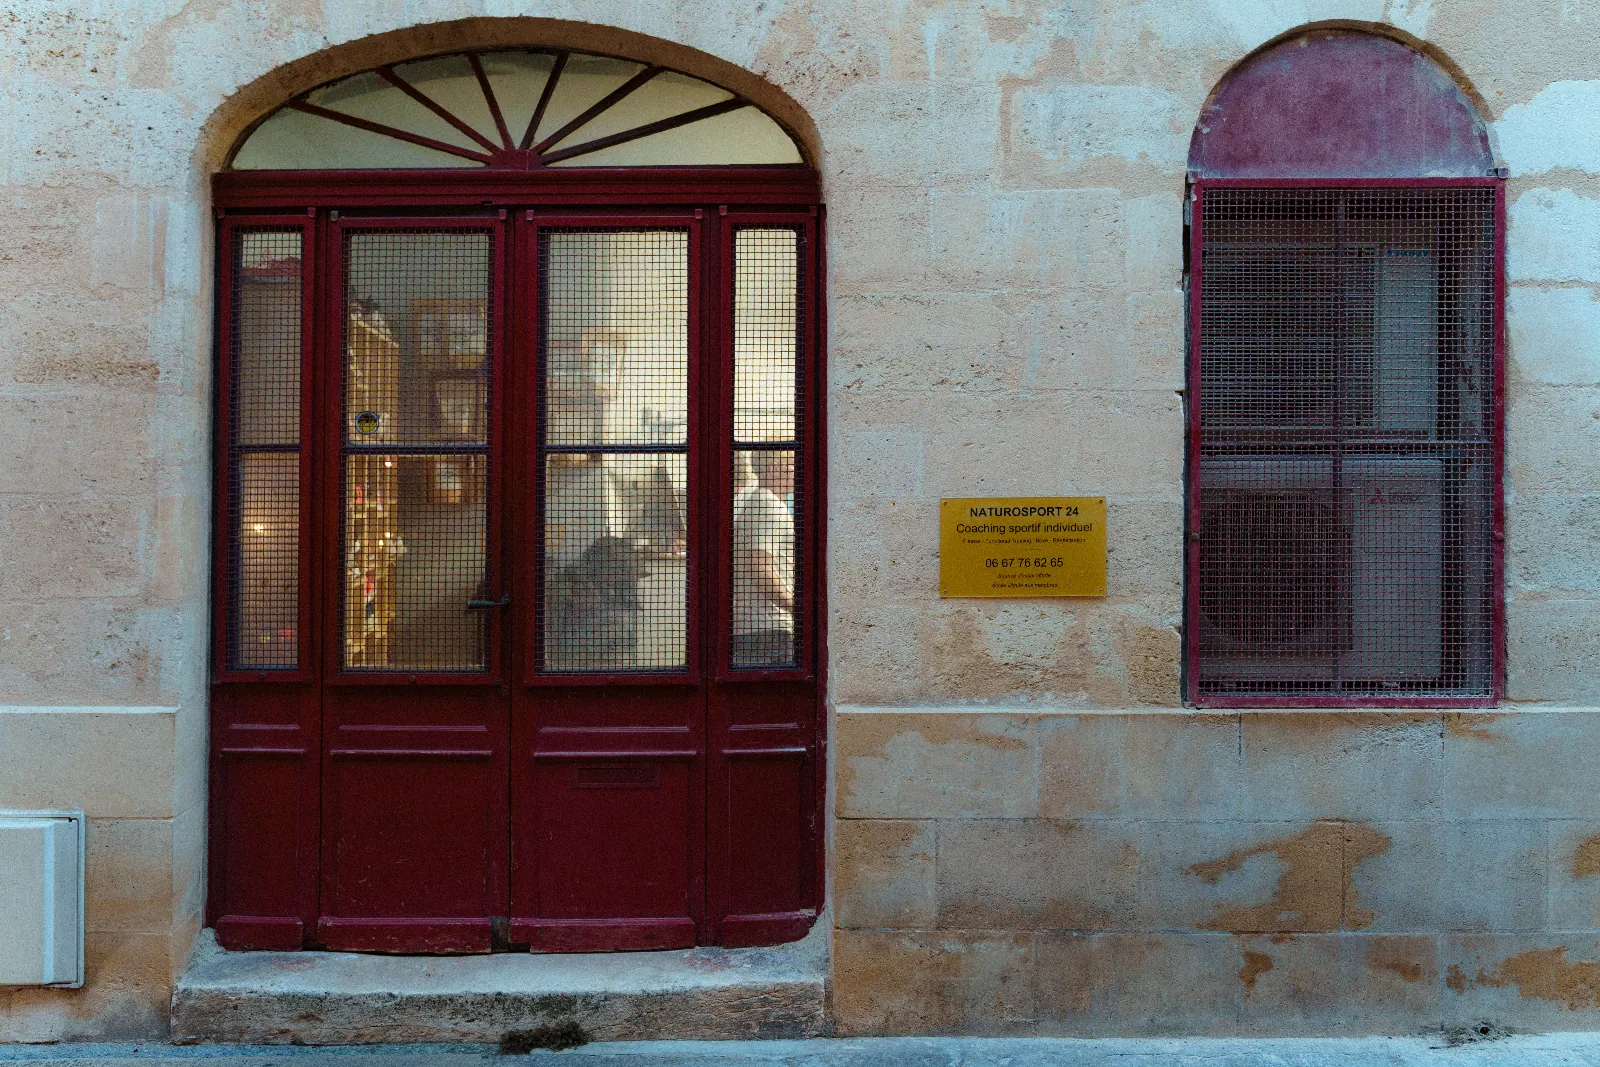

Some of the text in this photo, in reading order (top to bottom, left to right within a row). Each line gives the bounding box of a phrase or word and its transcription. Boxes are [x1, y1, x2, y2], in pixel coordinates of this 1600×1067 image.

[970, 506, 1079, 517] NATUROSPORT 24
[956, 522, 1093, 535] Coaching sportif individuel
[985, 557, 1064, 568] 06 67 76 62 65
